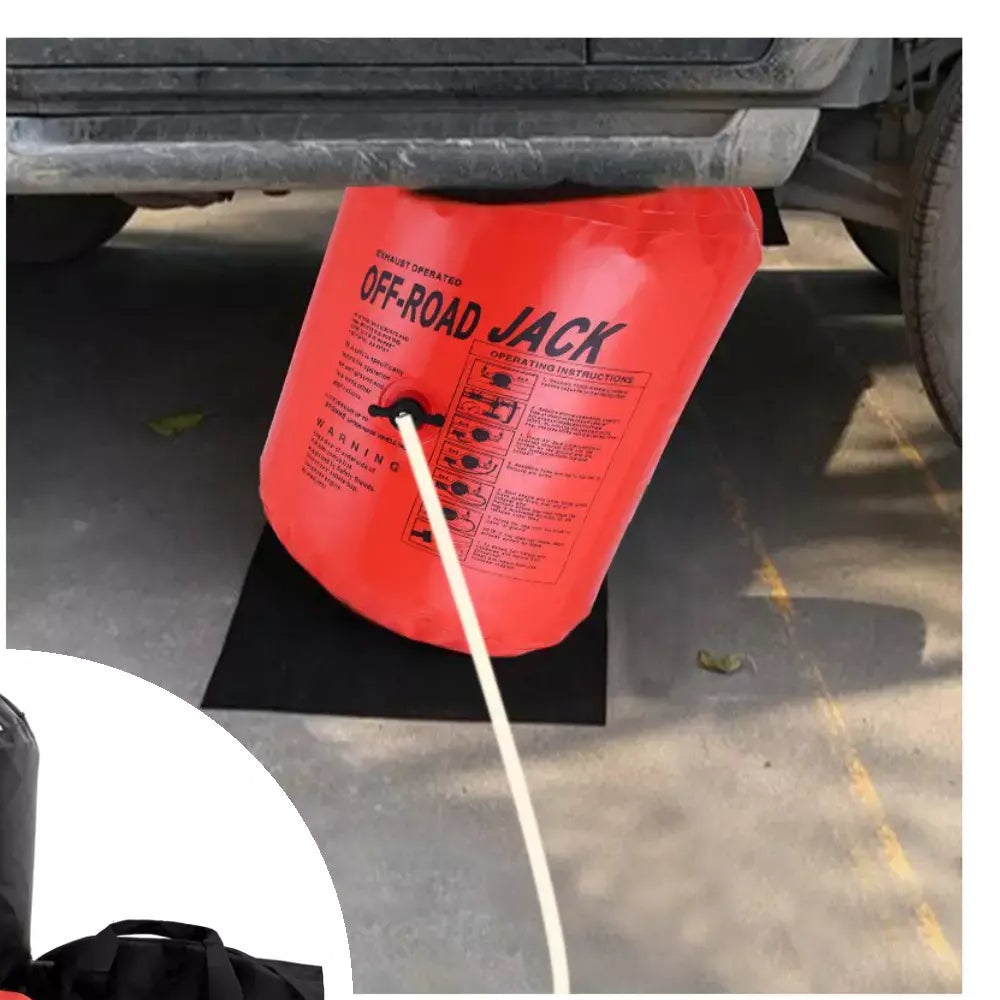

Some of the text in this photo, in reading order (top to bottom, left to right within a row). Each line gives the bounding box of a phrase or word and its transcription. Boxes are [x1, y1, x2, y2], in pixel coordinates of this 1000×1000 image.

[375, 249, 463, 288] EXHAUST OPERATED
[360, 264, 482, 341] OFF-ROAD
[487, 306, 628, 365] JACK
[490, 350, 634, 385] OPERATING INSTRUCTIONS
[316, 416, 400, 473] WARNING
